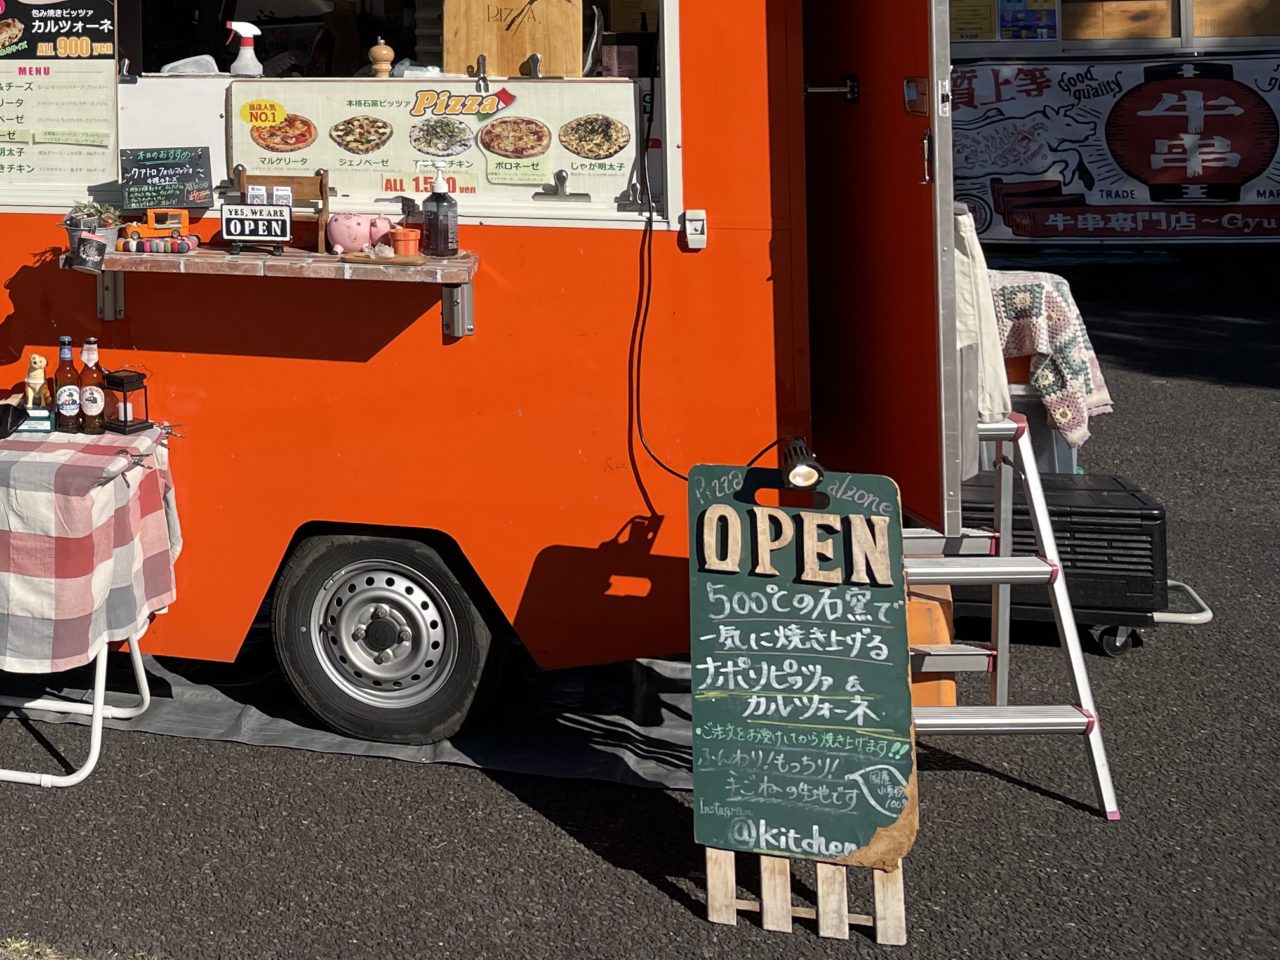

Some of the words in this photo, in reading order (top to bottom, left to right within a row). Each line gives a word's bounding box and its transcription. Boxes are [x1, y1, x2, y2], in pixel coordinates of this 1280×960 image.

[31, 8, 94, 18] 包み焼きピッツァ
[31, 19, 114, 34] カルツォーネ
[36, 41, 56, 56] ALL
[56, 36, 91, 58] 900
[92, 42, 114, 56] yen
[18, 66, 51, 76] MENU
[1057, 65, 1098, 93] Good
[1073, 71, 1123, 106] quality
[409, 89, 500, 117] Pizza
[249, 111, 277, 123] NO.1
[1136, 90, 1245, 178] 牛串
[259, 157, 308, 166] マルゲリータ
[570, 161, 626, 171] じゃが明太子
[384, 178, 405, 192] ALL
[412, 176, 457, 193] 1.50
[1099, 190, 1137, 200] TRADE
[228, 208, 248, 217] YES,
[251, 208, 264, 217] WE
[266, 209, 285, 218] ARE
[229, 219, 282, 236] OPEN
[702, 502, 895, 586] OPEN
[699, 623, 890, 661] 一気に焼き上げる
[695, 656, 834, 693] ナポリピッツァ
[845, 674, 865, 693] &
[741, 694, 881, 727] カルツォーネ
